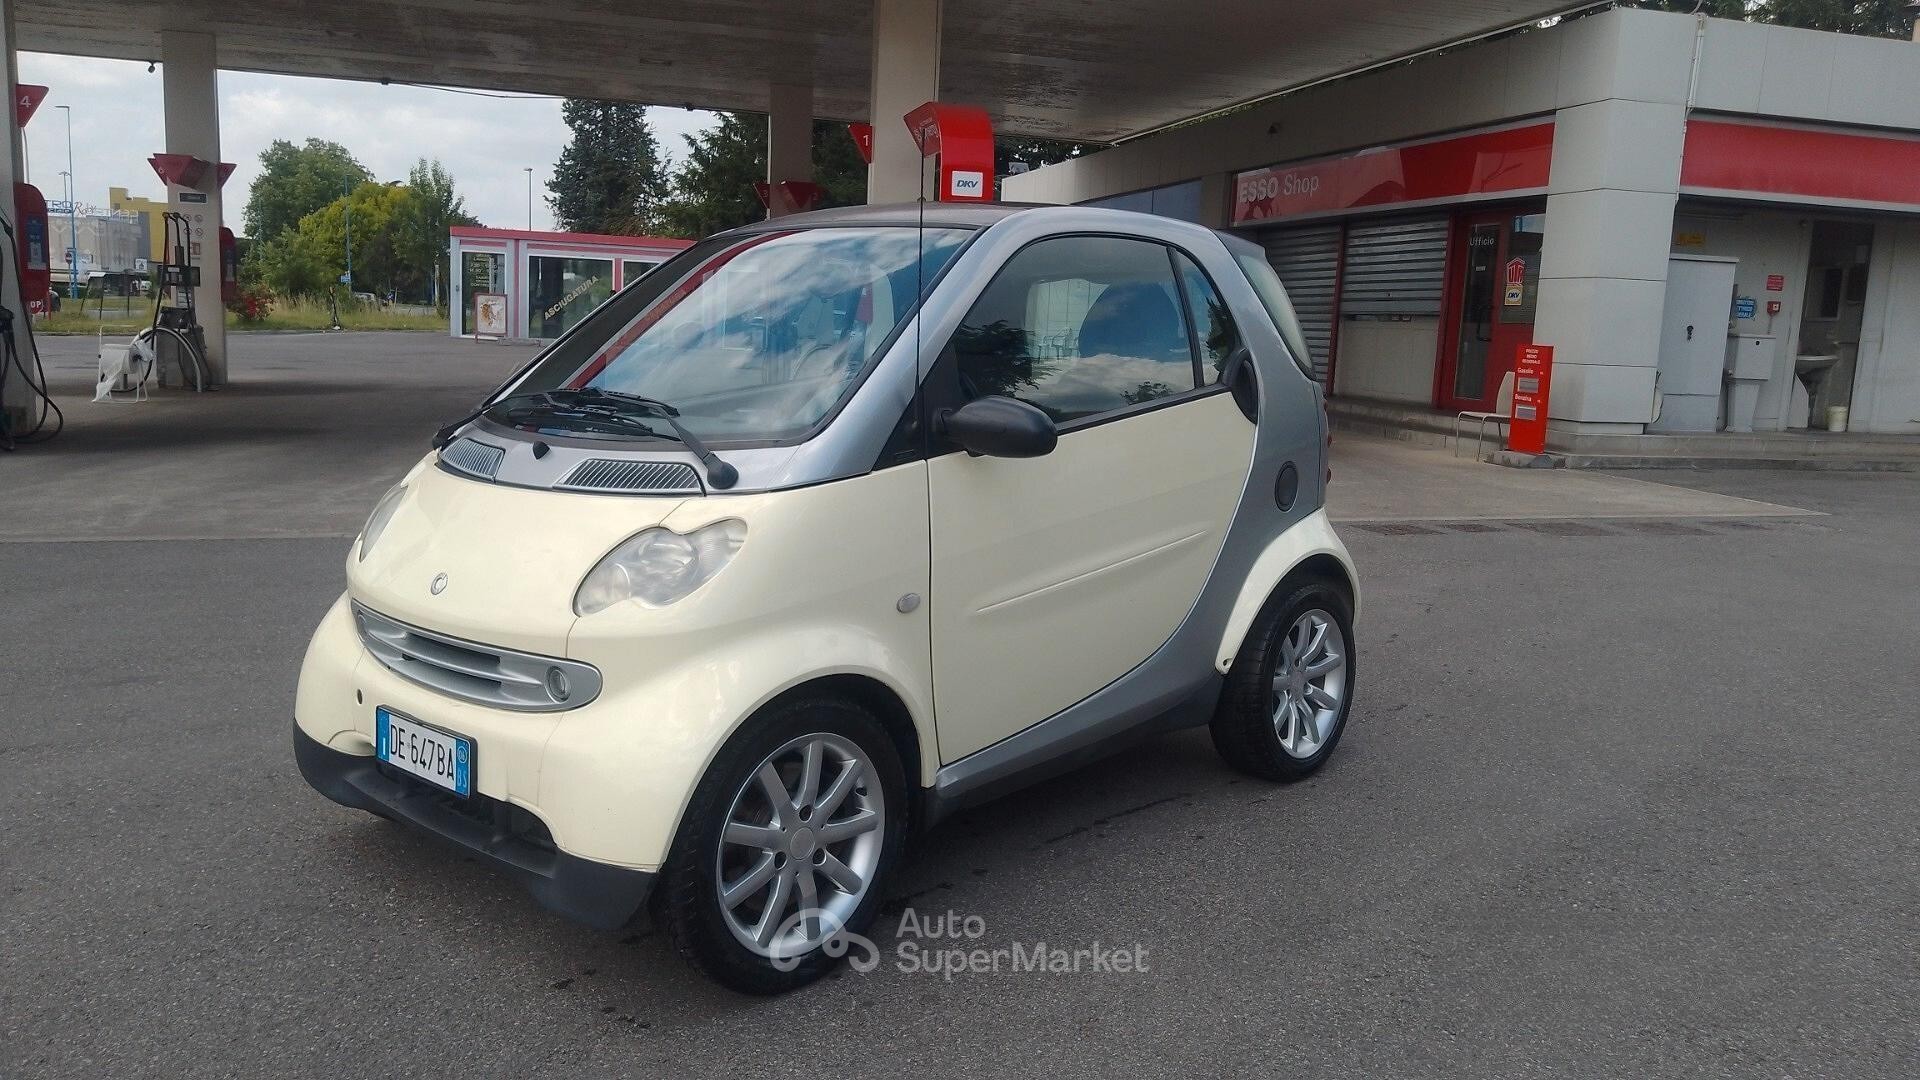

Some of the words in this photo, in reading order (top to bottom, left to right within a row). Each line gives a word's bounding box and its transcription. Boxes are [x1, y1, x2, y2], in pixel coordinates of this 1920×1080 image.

[20, 95, 31, 108] 4
[863, 135, 869, 147] 1
[957, 180, 979, 188] DKV
[1240, 177, 1278, 202] ESSO
[1284, 173, 1319, 197] Shop
[1470, 236, 1495, 247] Ufficio
[544, 275, 598, 320] ASCIUGATURA
[1508, 291, 1520, 299] DKV
[390, 724, 406, 760] DE
[410, 732, 454, 780] 647BA
[457, 766, 467, 788] BS
